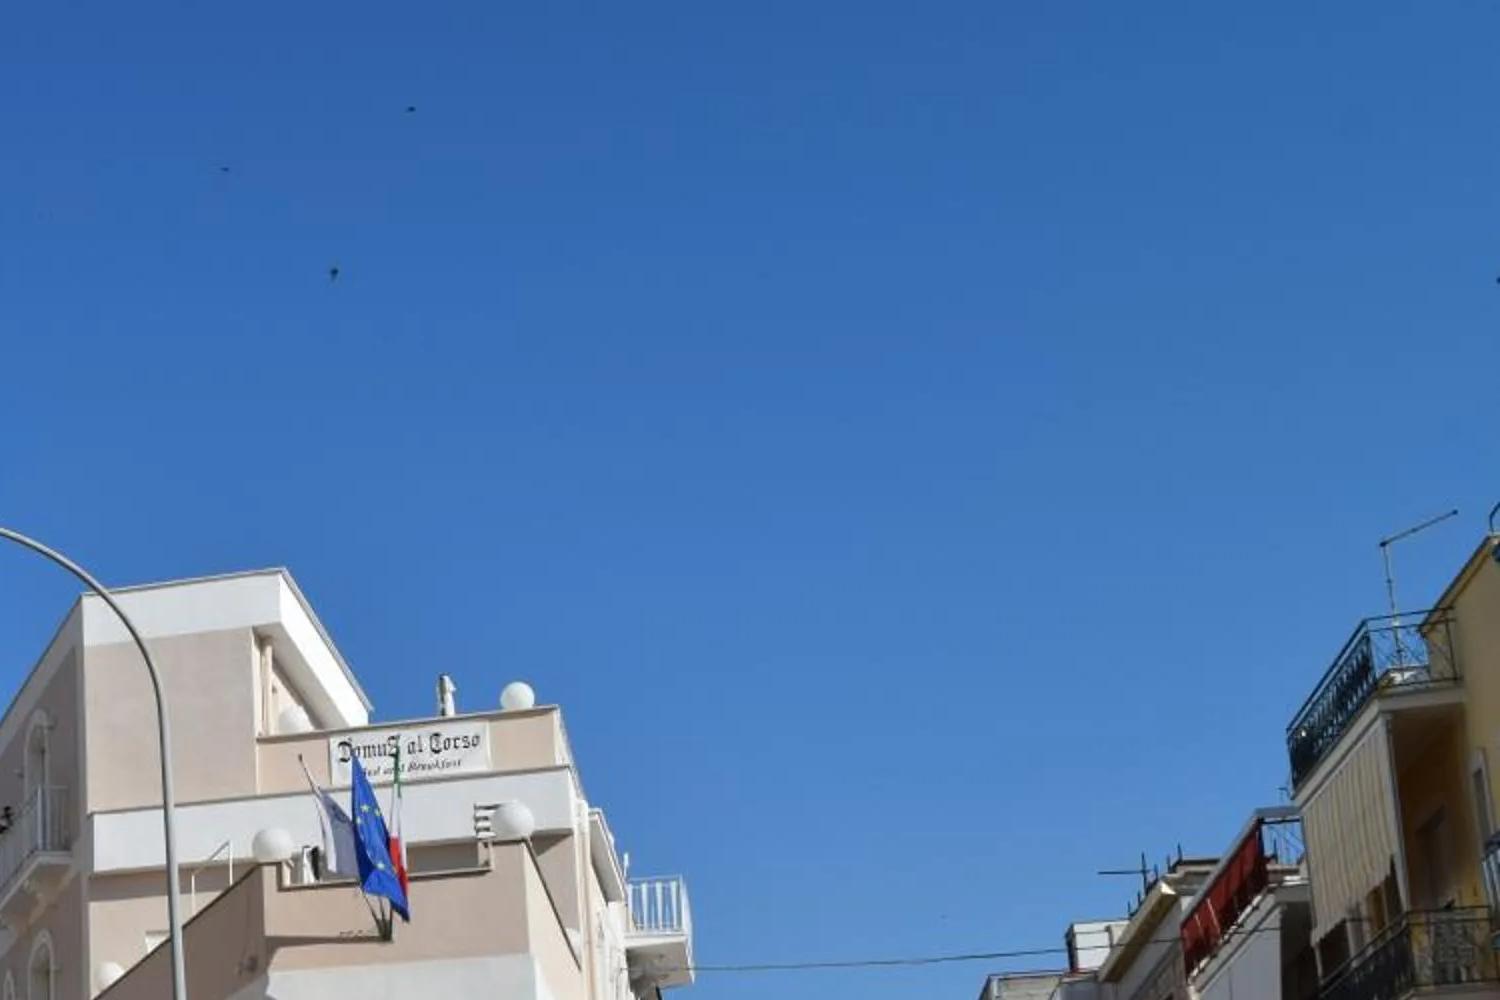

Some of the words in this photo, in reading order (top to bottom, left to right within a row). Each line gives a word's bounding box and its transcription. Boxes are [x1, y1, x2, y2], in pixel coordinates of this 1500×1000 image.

[407, 737, 424, 755] al
[430, 733, 481, 755] Corso
[407, 758, 463, 773] Breakfast
